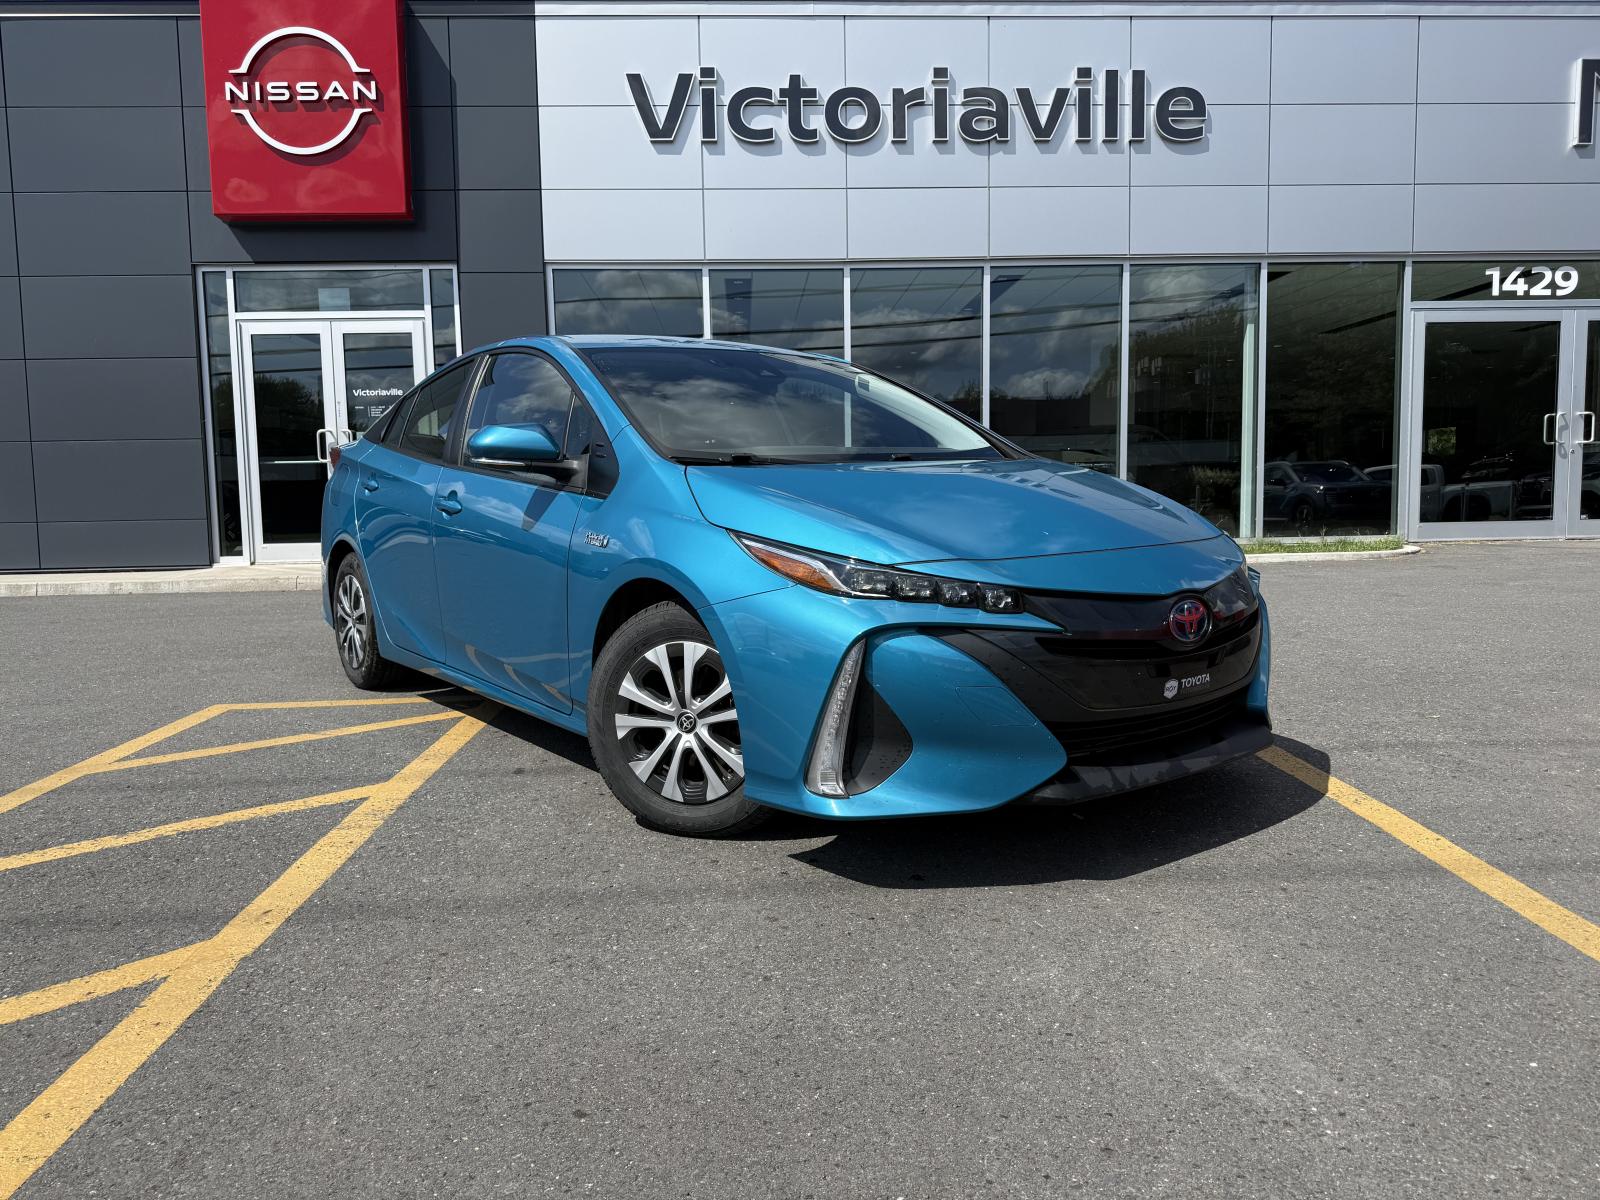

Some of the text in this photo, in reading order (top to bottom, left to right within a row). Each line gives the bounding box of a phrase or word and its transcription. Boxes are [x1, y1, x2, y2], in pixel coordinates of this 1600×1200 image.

[224, 80, 377, 101] NISSAN
[625, 66, 1207, 142] Victoriaville
[1485, 265, 1579, 297] 1429
[353, 388, 403, 396] Victoriaville
[1181, 673, 1210, 688] TOYOTA
